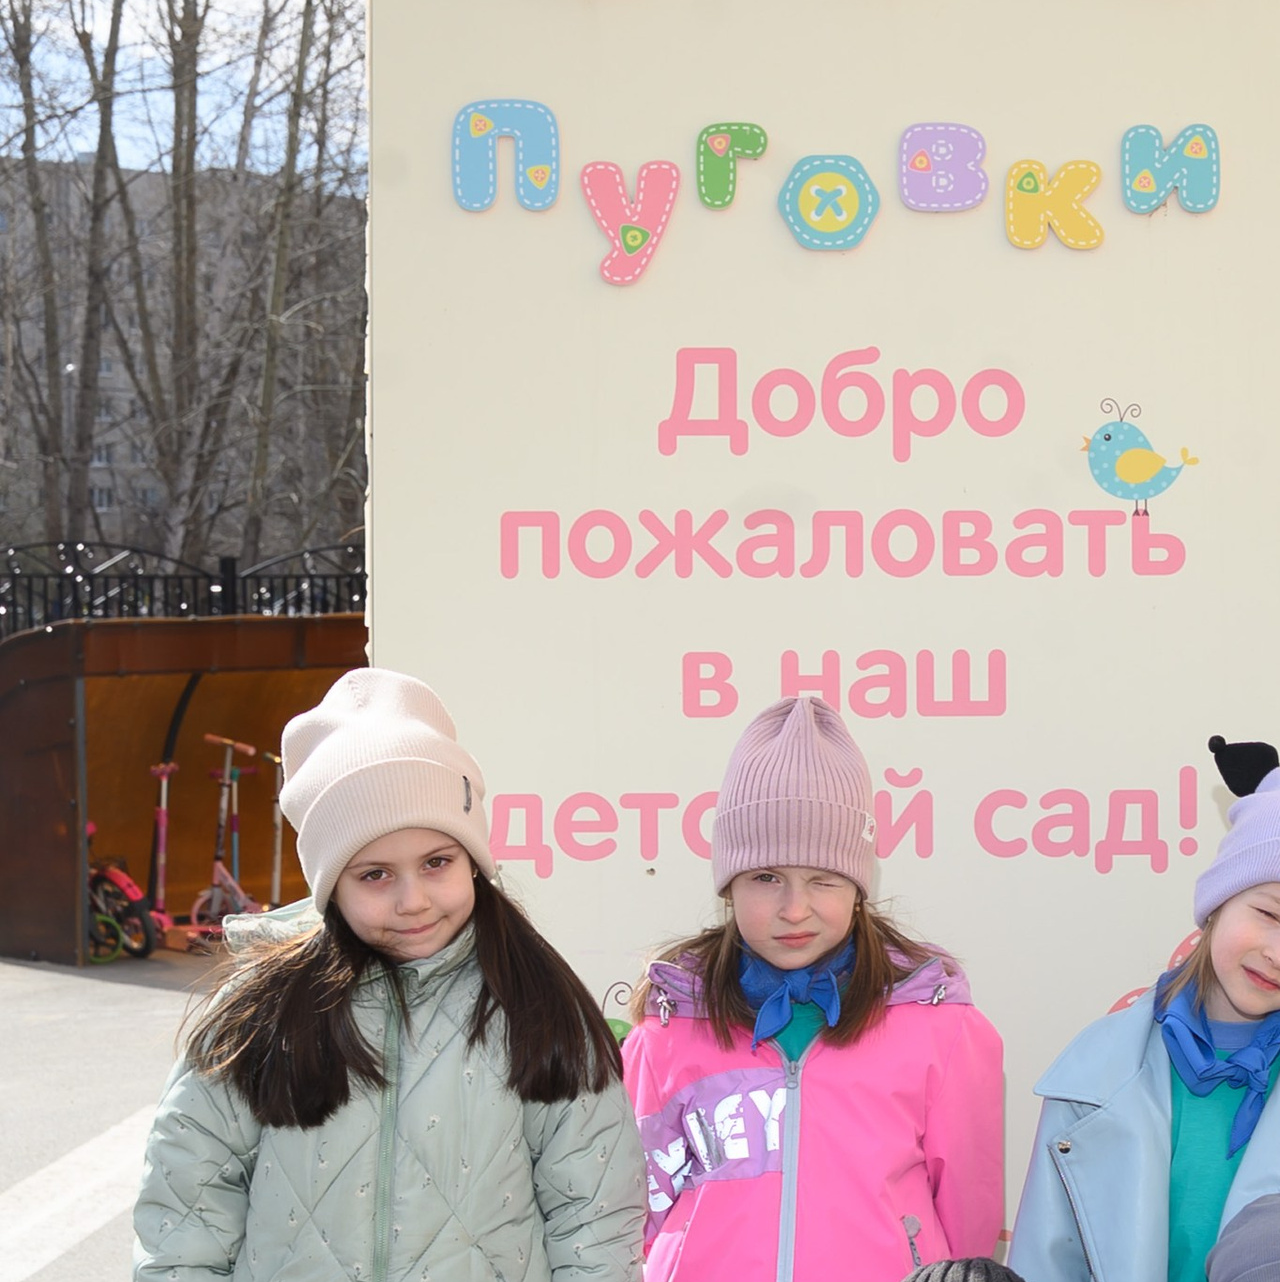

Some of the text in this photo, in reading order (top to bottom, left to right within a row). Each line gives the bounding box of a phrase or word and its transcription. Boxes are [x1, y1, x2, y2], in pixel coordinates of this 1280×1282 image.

[658, 346, 1025, 463] Добро
[500, 508, 1187, 579] пожаловать
[682, 649, 1007, 718] в наш
[974, 765, 1199, 874] сад!
